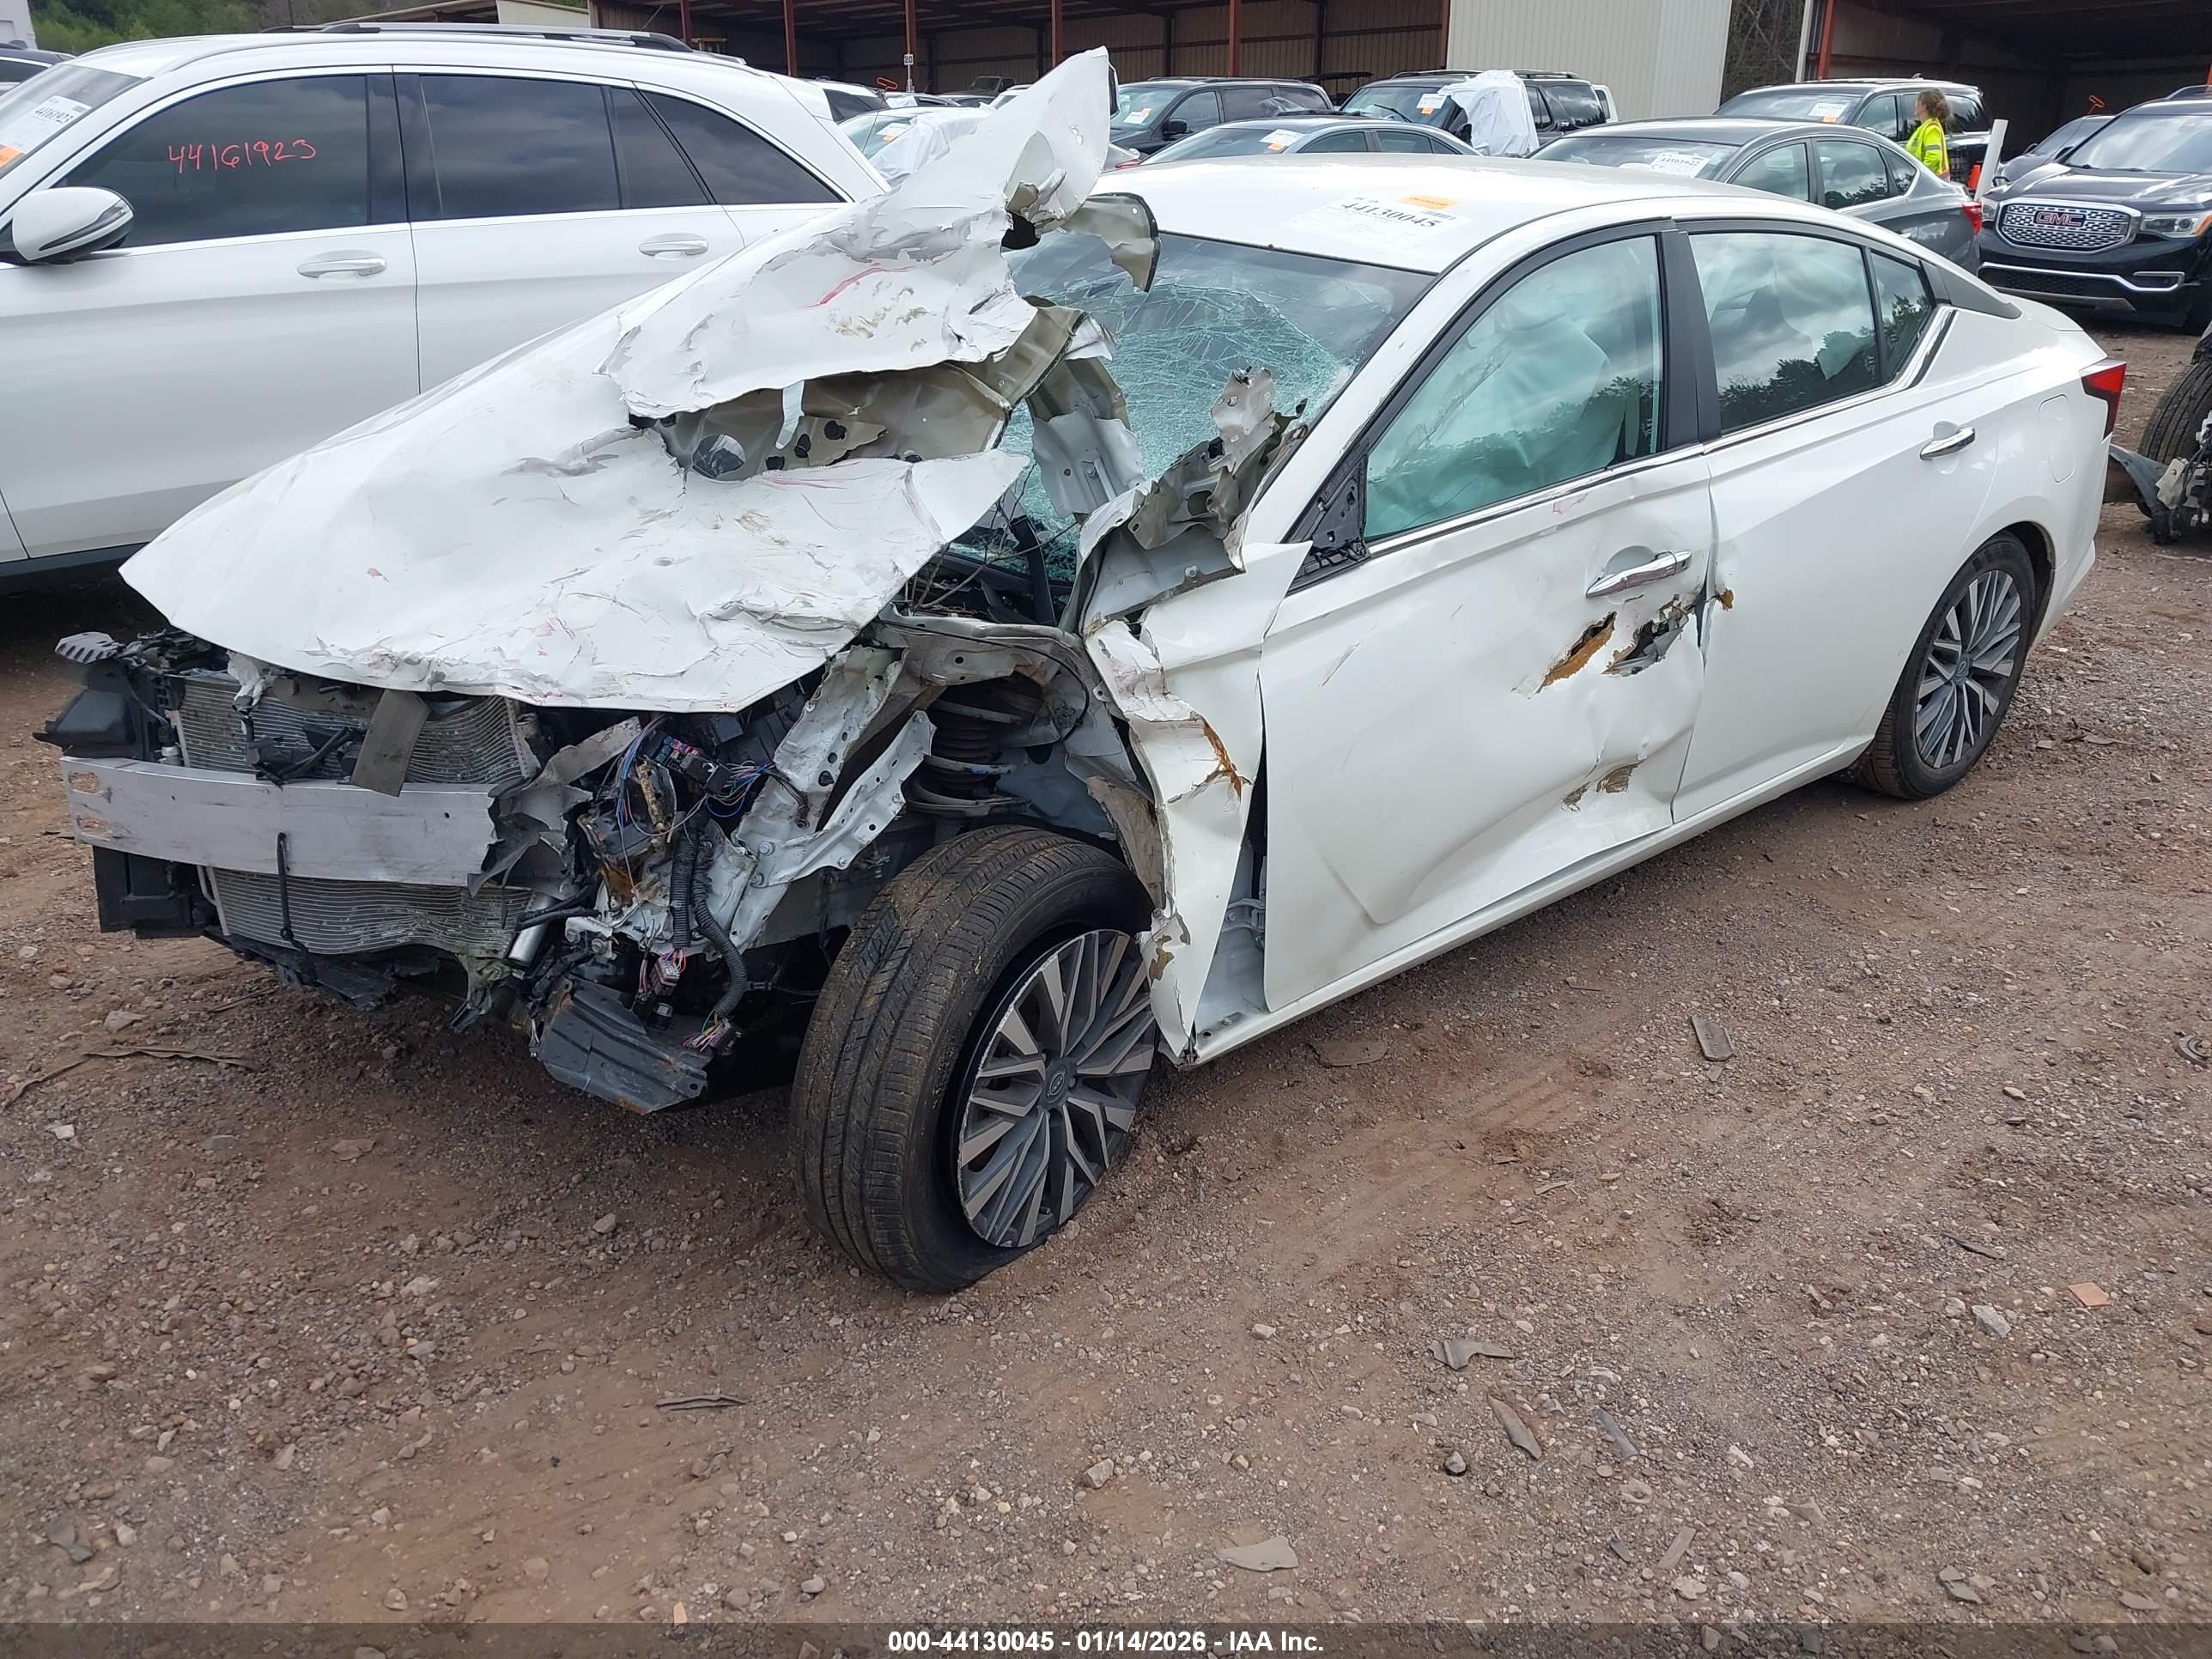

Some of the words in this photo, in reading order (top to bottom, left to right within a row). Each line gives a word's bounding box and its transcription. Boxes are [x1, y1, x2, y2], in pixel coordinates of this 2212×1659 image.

[904, 55, 913, 64] 20
[168, 138, 317, 173] 44161923
[1341, 203, 1442, 228] 44130045
[2036, 211, 2084, 227] GMC
